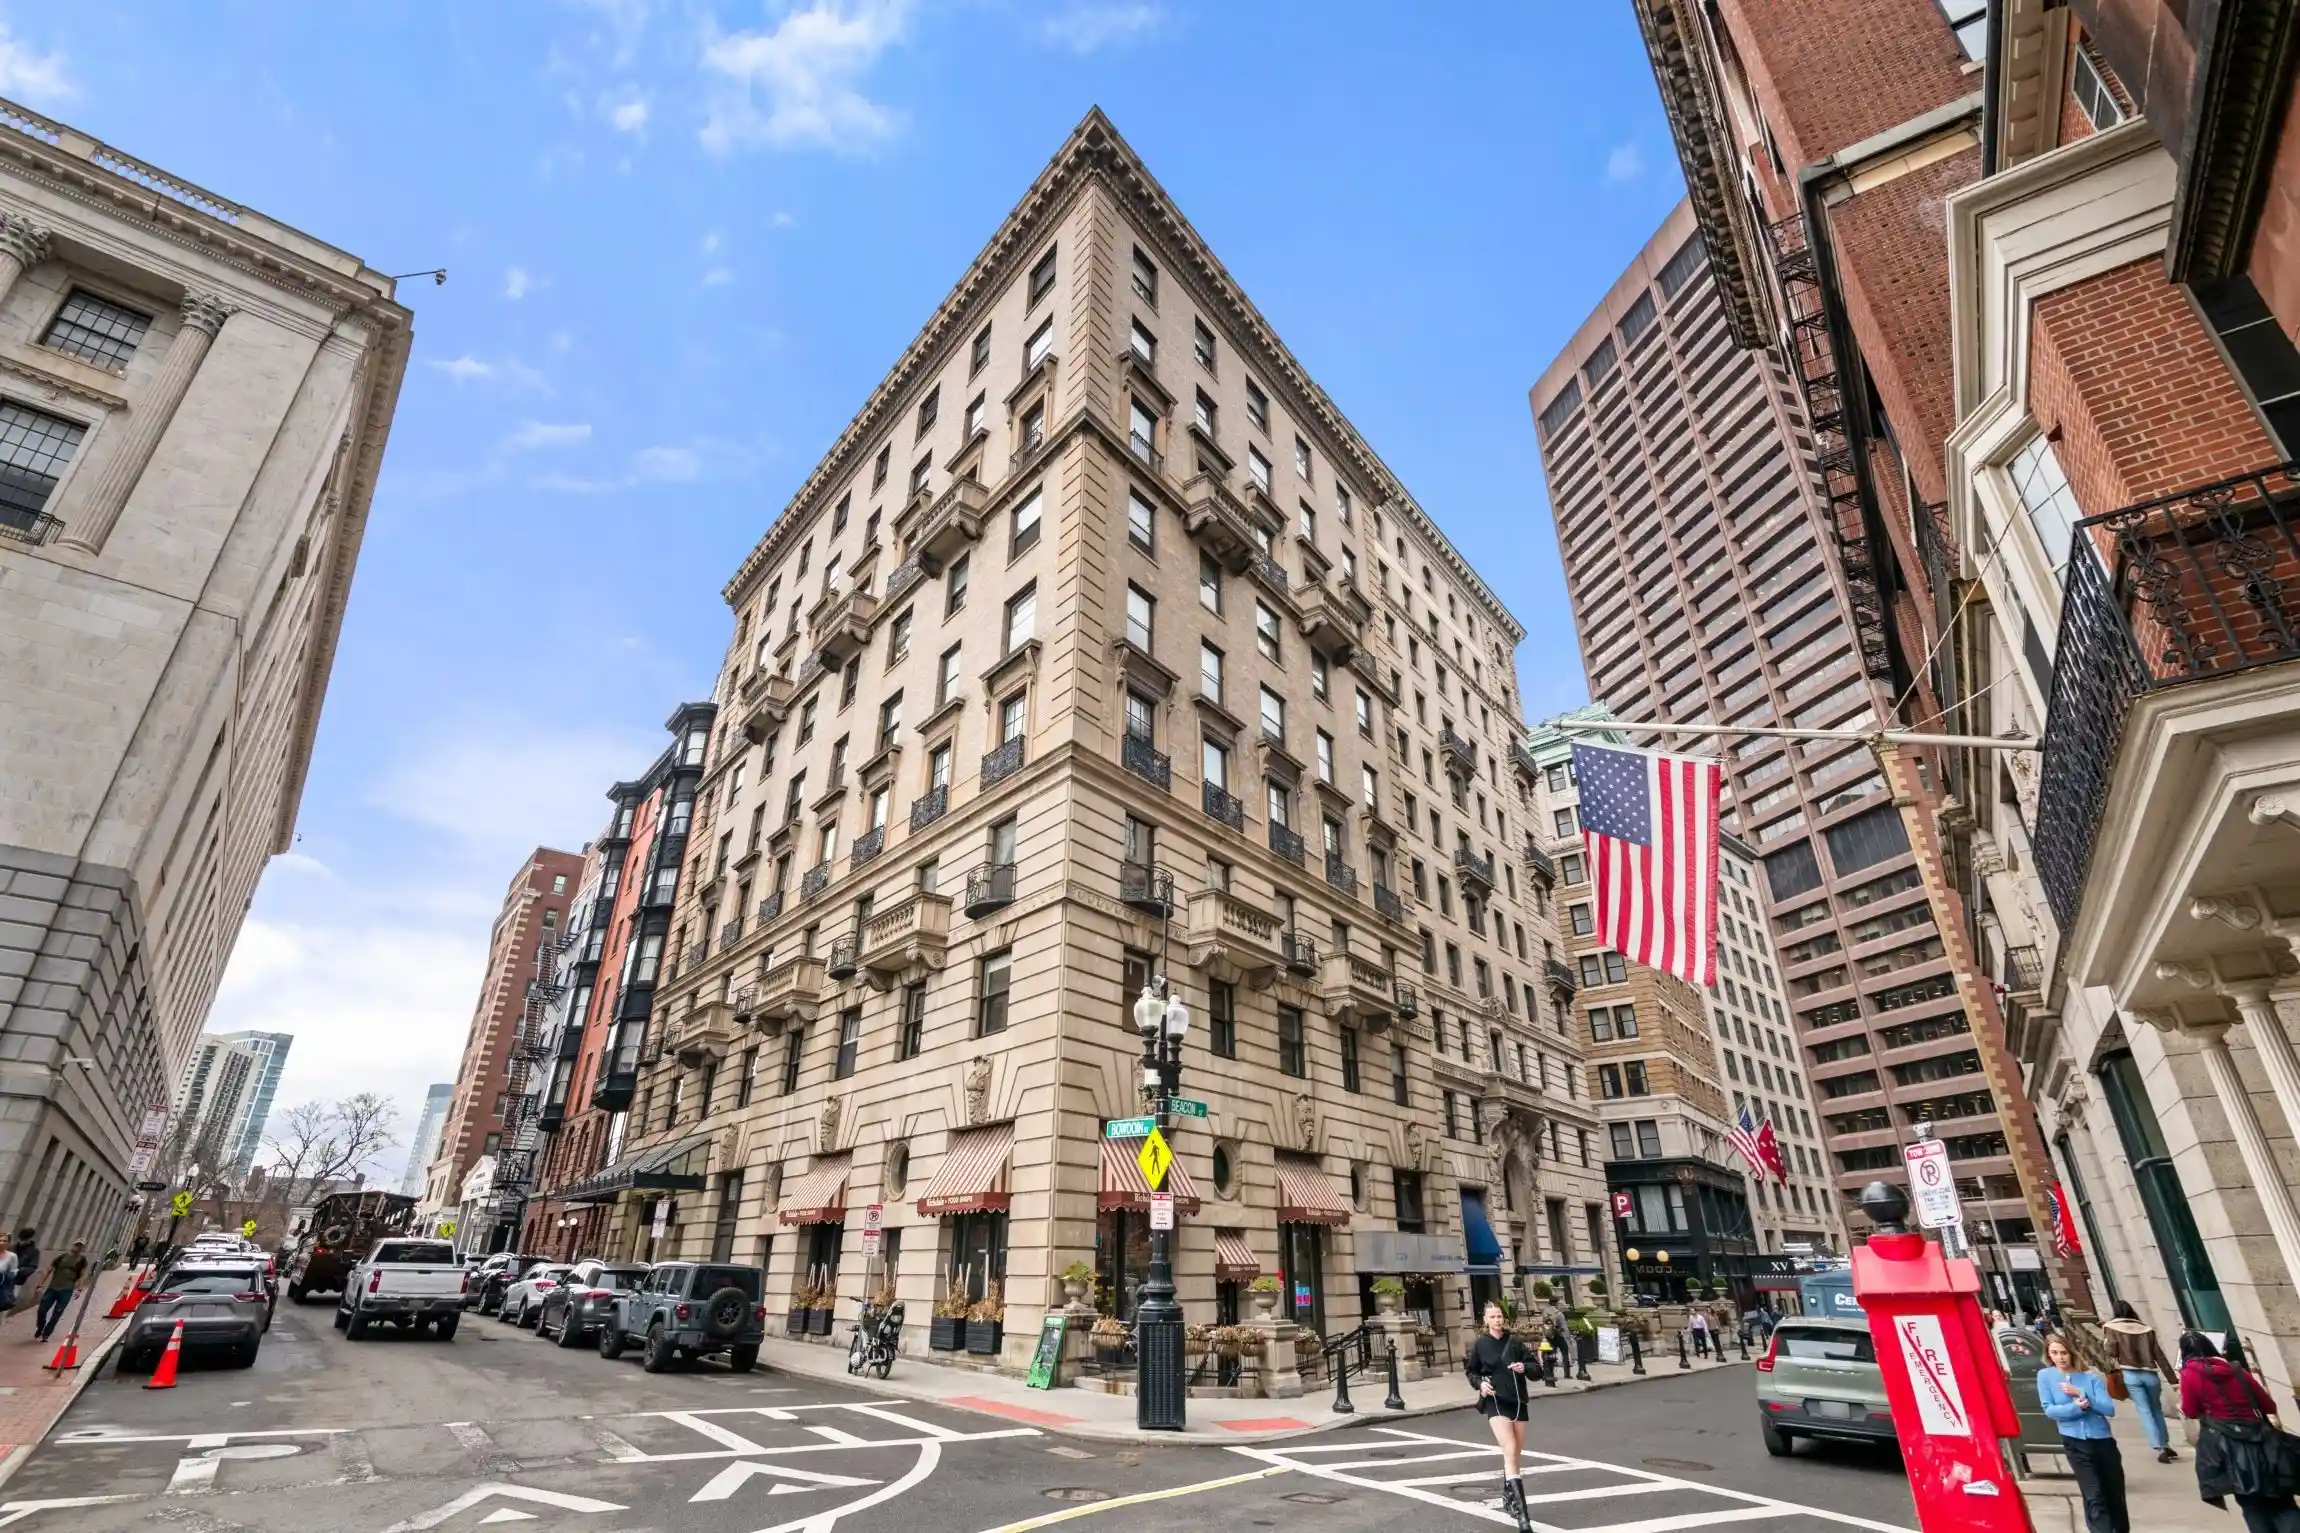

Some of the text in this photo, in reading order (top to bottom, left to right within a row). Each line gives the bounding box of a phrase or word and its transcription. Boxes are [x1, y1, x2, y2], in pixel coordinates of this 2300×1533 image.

[1171, 1099, 1196, 1115] BEACON
[1111, 1121, 1144, 1136] BOWDOIN
[947, 1196, 959, 1205] FOOD
[1616, 1195, 1628, 1211] P
[1771, 1261, 1789, 1272] XV
[1907, 1321, 1948, 1376] FIRE
[1909, 1352, 1956, 1428] EMERGENCY
